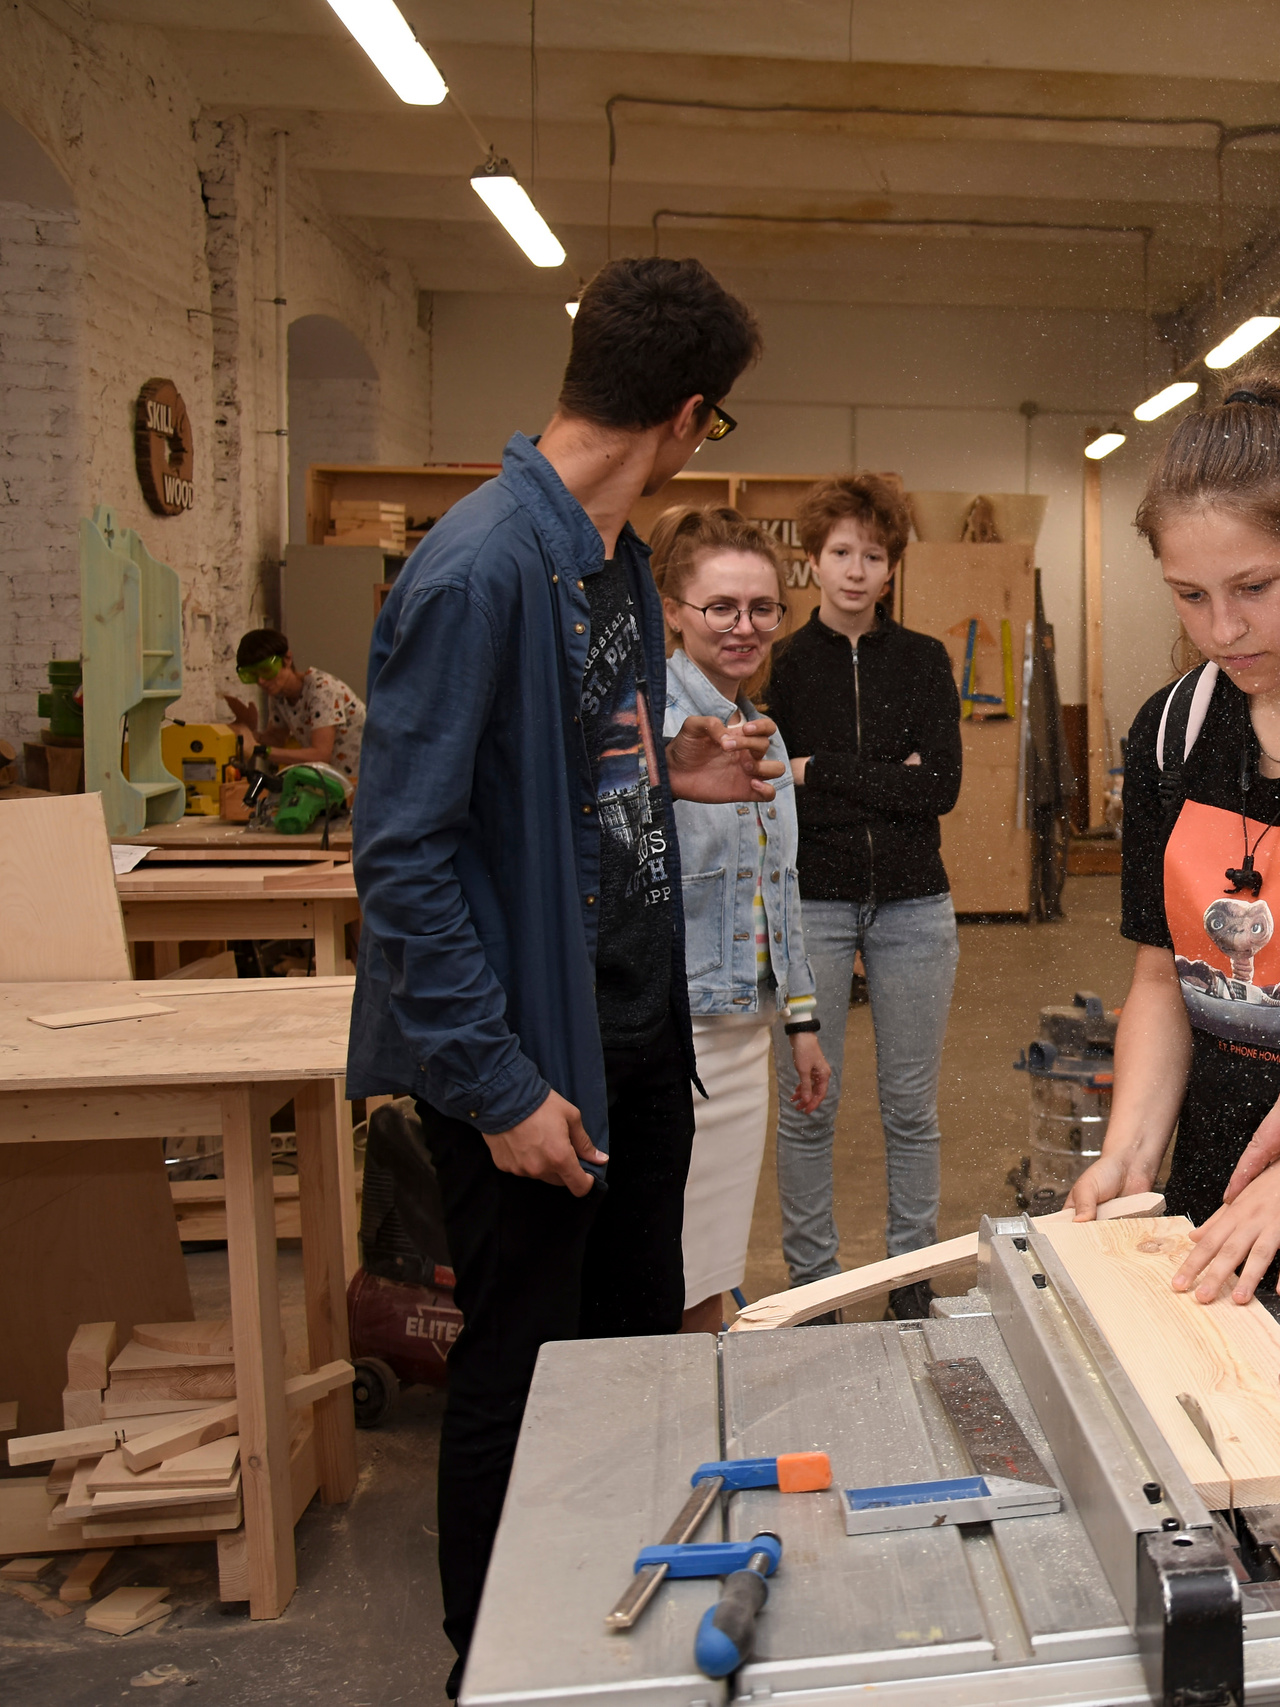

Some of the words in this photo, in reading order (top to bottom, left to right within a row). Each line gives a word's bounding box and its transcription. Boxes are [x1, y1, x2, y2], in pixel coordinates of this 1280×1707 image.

[147, 400, 174, 434] SKILL
[164, 474, 194, 510] WOOD
[583, 612, 624, 676] ussian
[1230, 1044, 1258, 1059] PHONE
